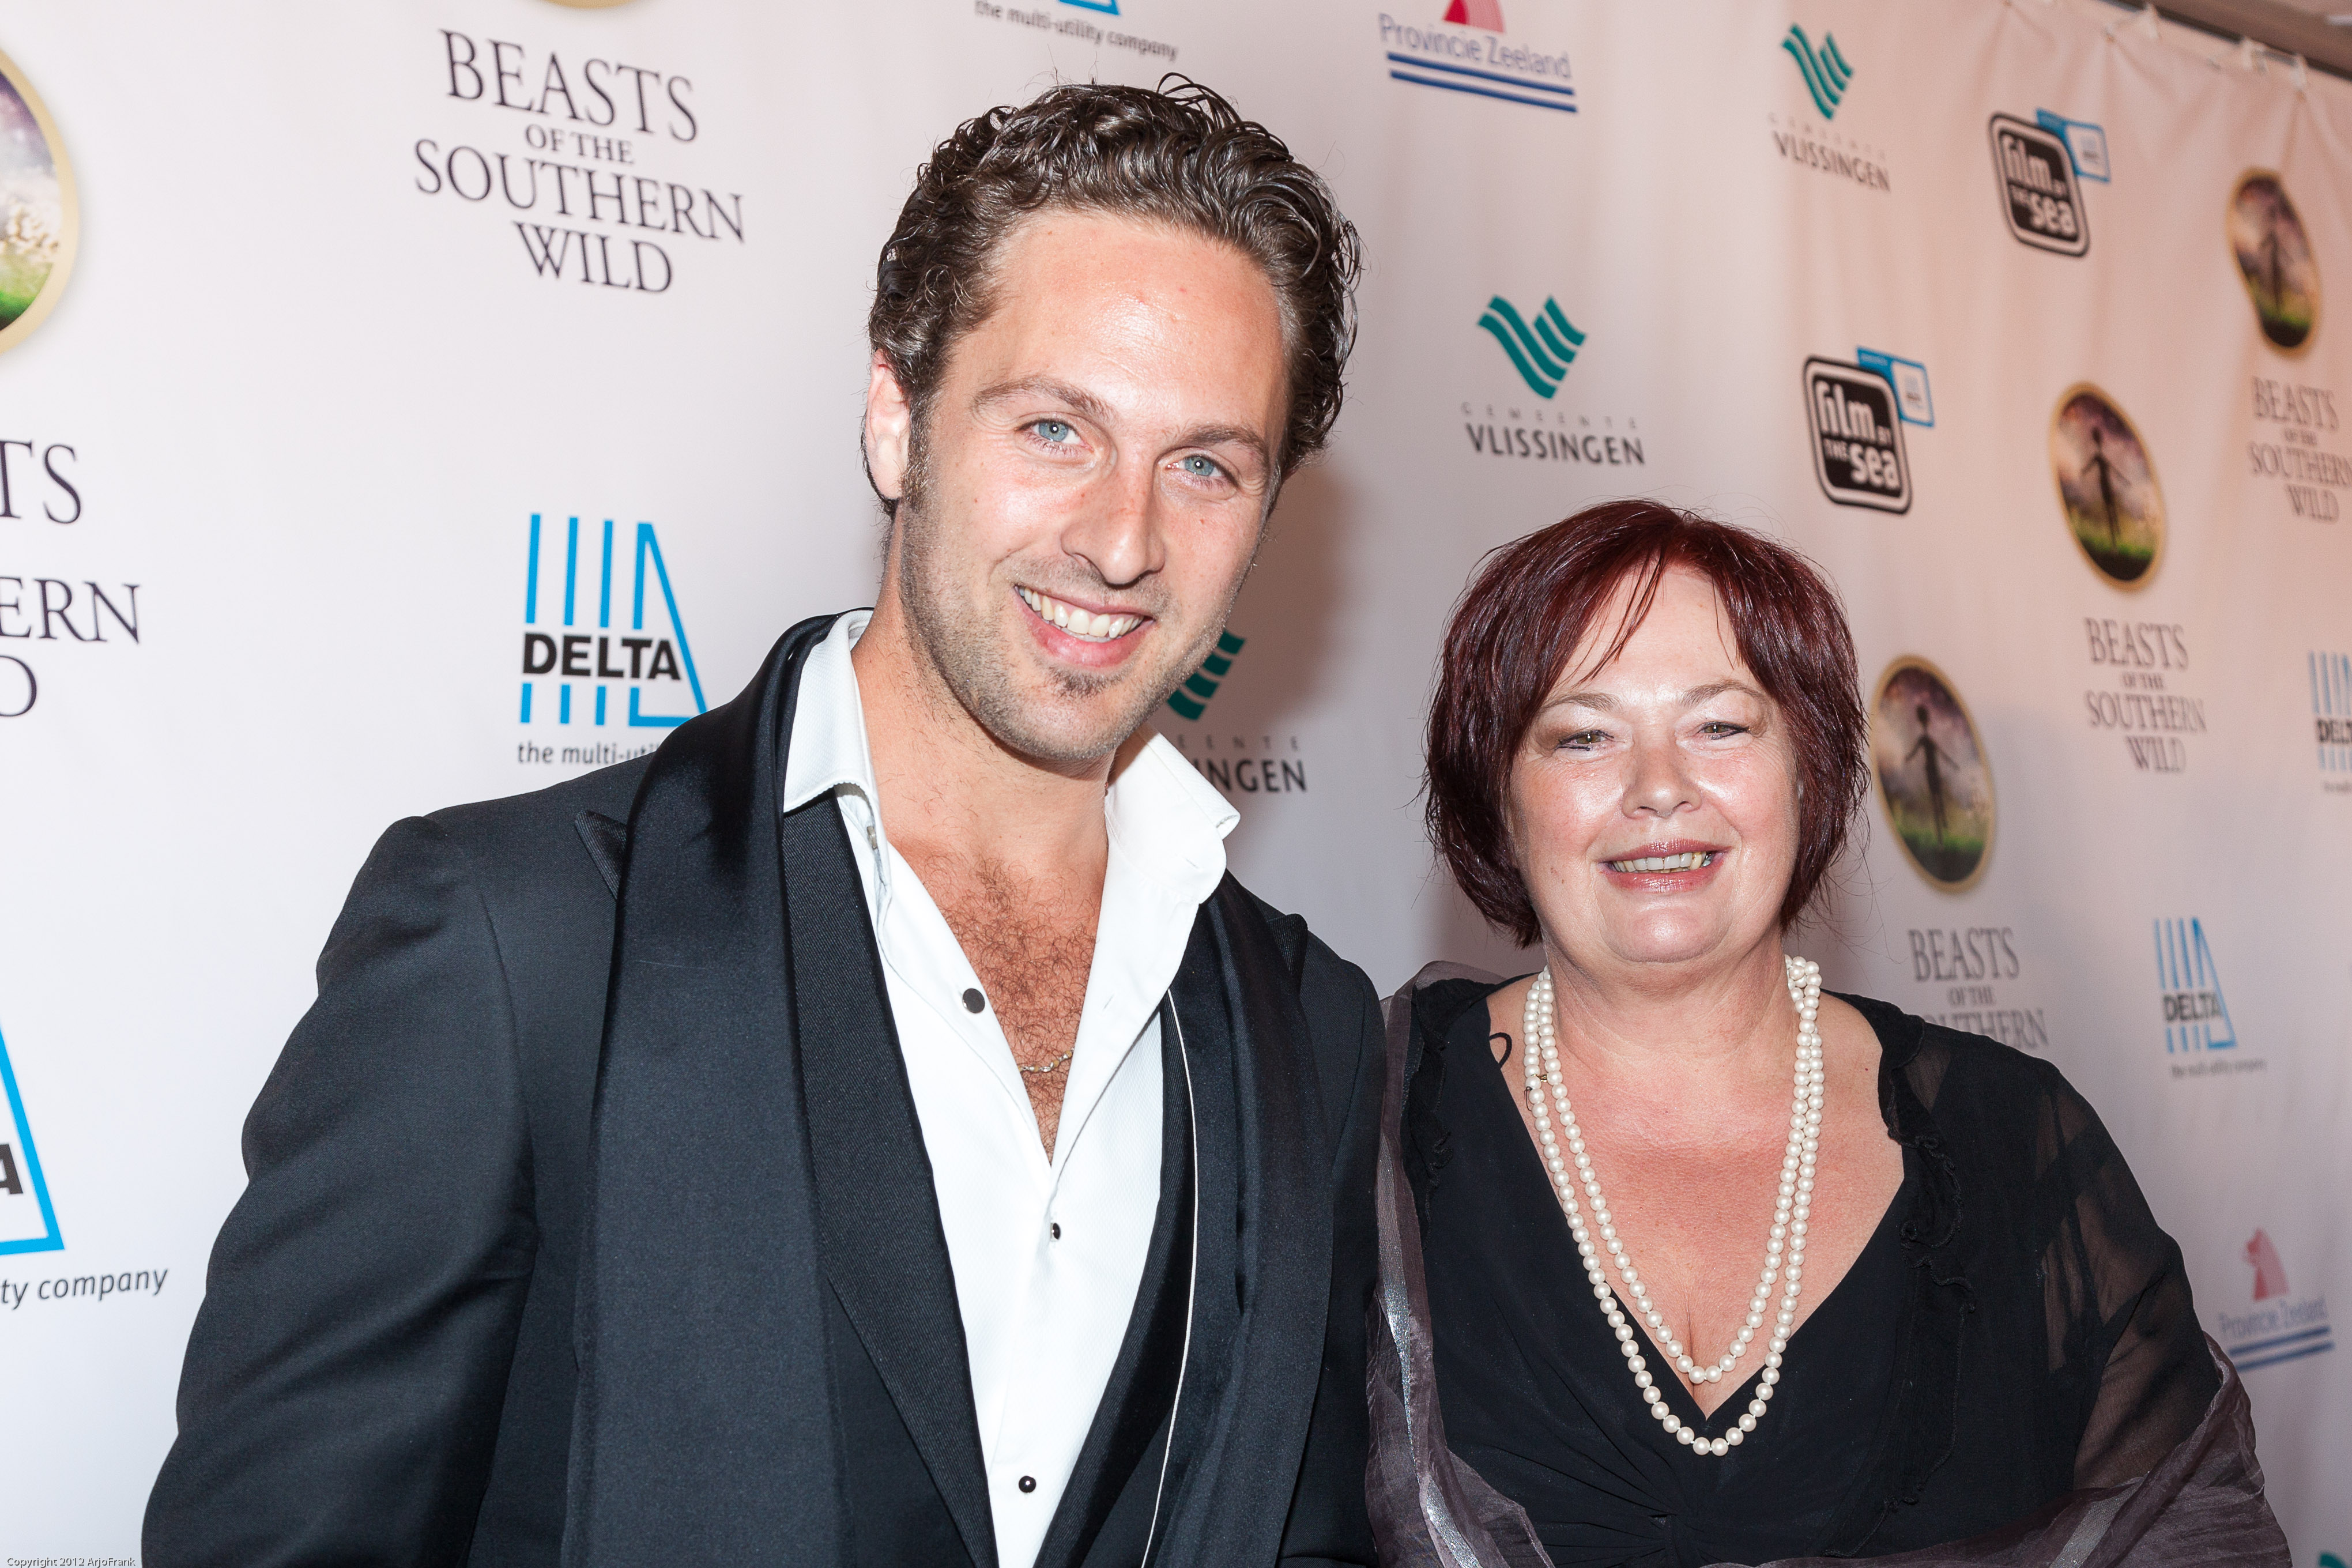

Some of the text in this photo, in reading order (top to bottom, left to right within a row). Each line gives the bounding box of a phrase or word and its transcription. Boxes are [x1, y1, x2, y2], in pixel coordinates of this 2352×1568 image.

[975, 0, 1178, 61] the multi-utility company
[1379, 13, 1571, 78] Provincie Zeeland
[439, 28, 698, 142] BEASTS
[525, 123, 635, 164] OF THE
[1773, 130, 1890, 192] VLISSINGEN
[2002, 134, 2052, 193] film
[414, 139, 746, 244] SOUTHERN
[2029, 193, 2077, 235] sea
[513, 220, 673, 293] WILD
[1461, 402, 1636, 429] GEMEENTE
[1815, 379, 1876, 444] film
[2252, 375, 2339, 431] BEASTS
[1465, 423, 1645, 465] VLISSINGEN
[1849, 442, 1901, 489] sea
[2285, 484, 2340, 523] WILD
[522, 632, 681, 681] DELTA
[2084, 617, 2189, 670] BEASTS
[2084, 690, 2207, 733] SOUTHERN
[518, 741, 553, 763] the
[2125, 736, 2187, 773] WILD
[1908, 927, 2020, 982] BEASTS
[2163, 991, 2223, 1023] DELTA
[38, 1268, 168, 1301] company
